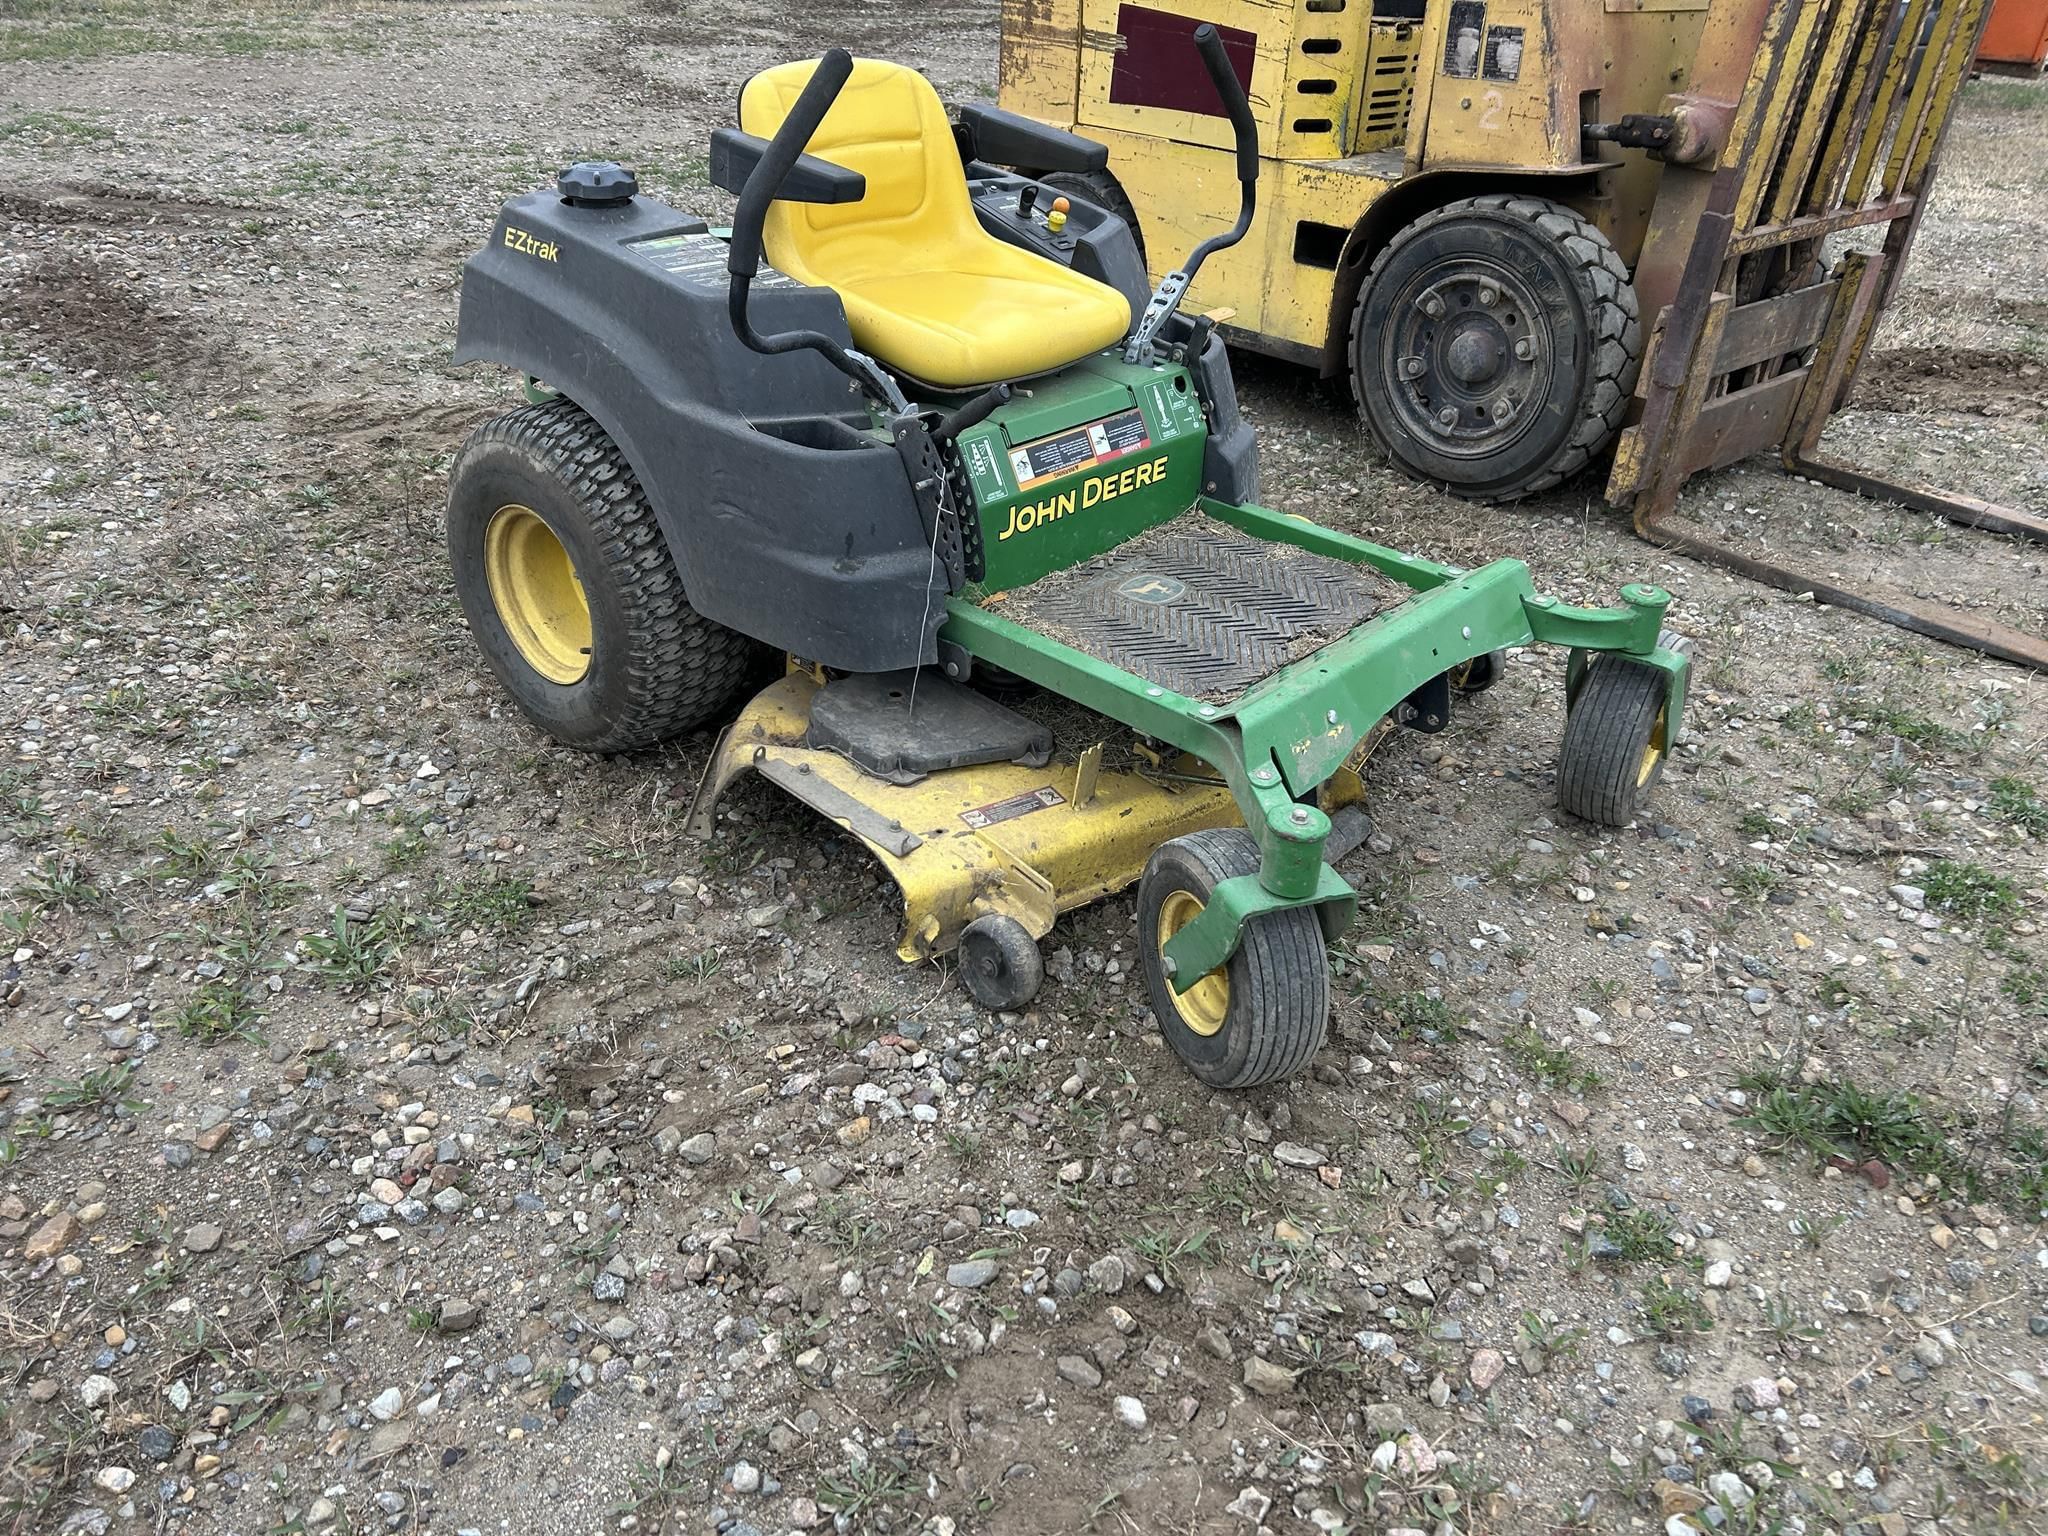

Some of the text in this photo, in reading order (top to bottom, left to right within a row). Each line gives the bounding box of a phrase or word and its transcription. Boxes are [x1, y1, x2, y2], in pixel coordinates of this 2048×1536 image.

[504, 226, 559, 263] EZtrak
[999, 456, 1168, 541] JOHN DEERE
